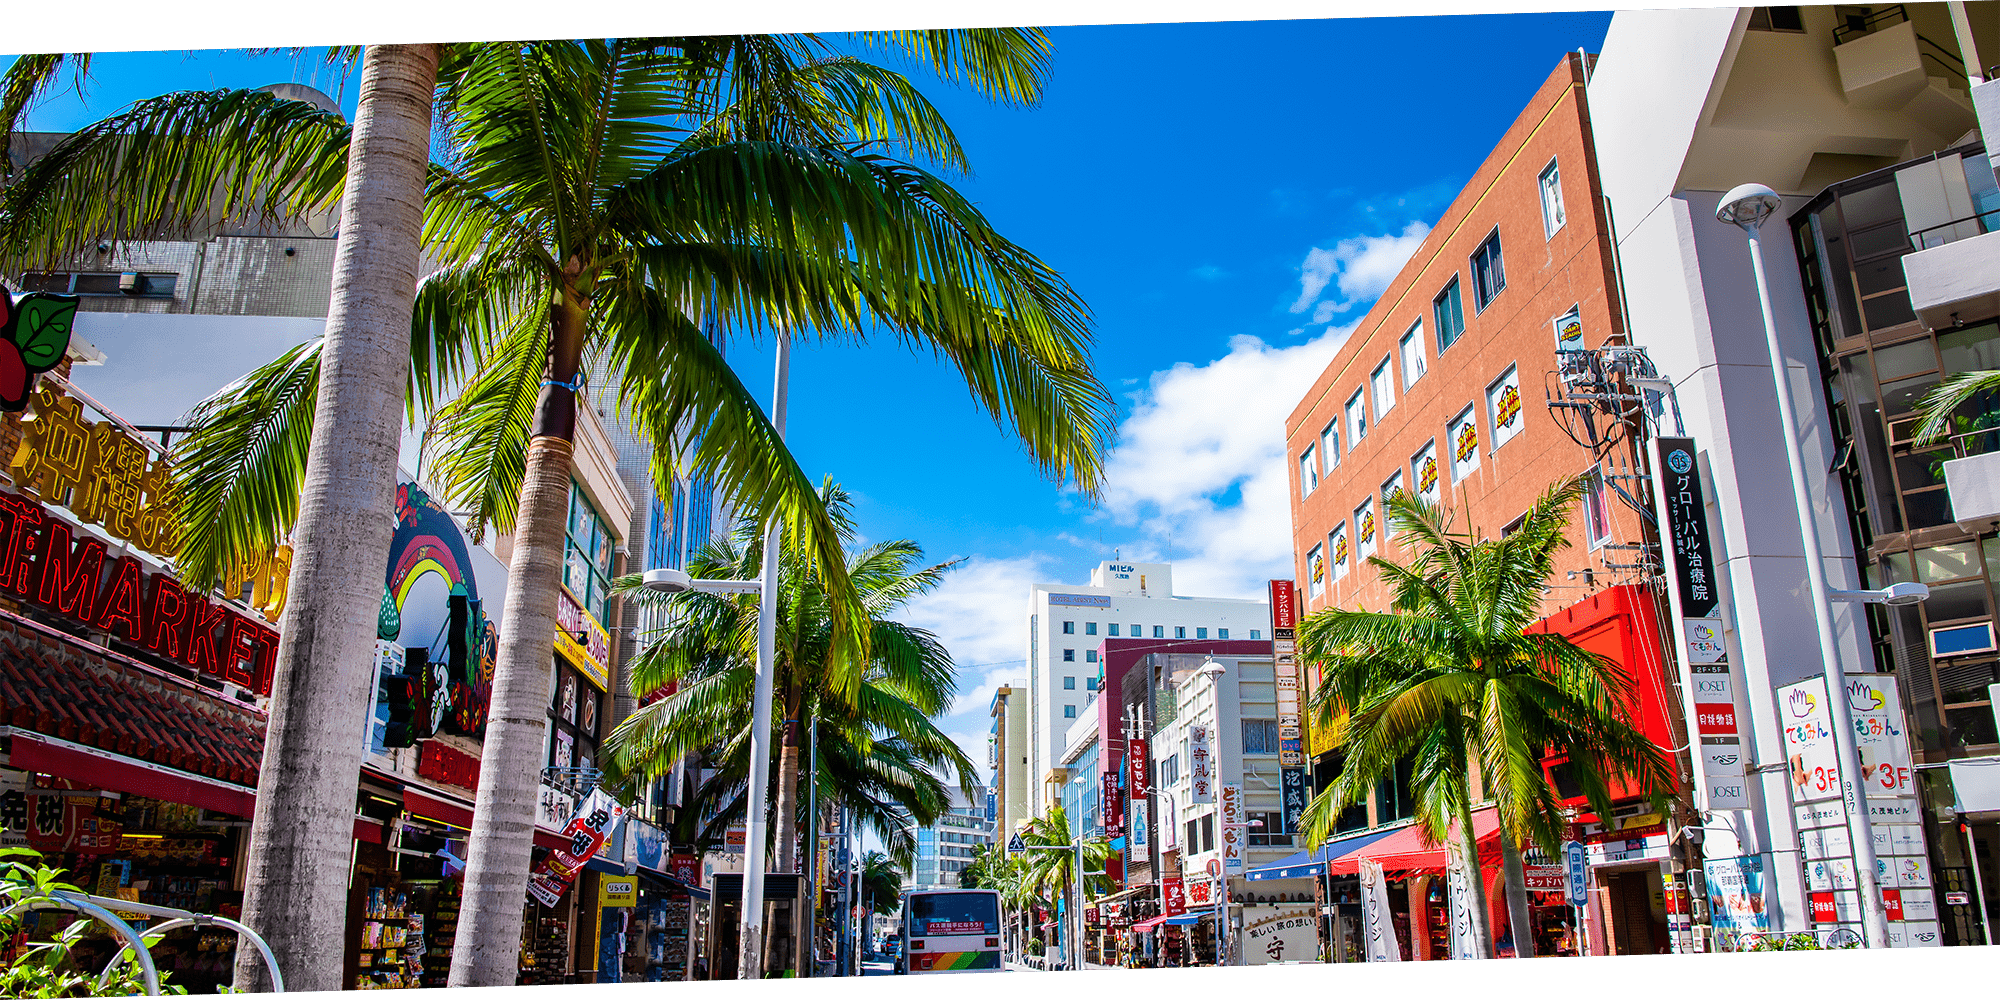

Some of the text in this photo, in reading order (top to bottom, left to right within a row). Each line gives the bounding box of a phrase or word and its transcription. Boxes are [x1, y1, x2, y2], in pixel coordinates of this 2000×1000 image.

[1677, 476, 1708, 600] グローバル治療院
[1109, 564, 1135, 573] MIビル
[0, 496, 281, 697] MARKET
[1711, 609, 1720, 618] 3F
[1690, 642, 1721, 652] てもみん
[1698, 680, 1726, 693] JOSET
[1786, 721, 1829, 744] てもみん
[1855, 718, 1900, 736] もみん
[1814, 766, 1838, 792] 3F
[1879, 763, 1910, 790] 3F
[1712, 786, 1741, 798] JOSET
[0, 788, 66, 837] 免税
[1802, 810, 1839, 820] GS久茂地ビル
[1871, 807, 1910, 815] 久茂地ビル
[571, 808, 610, 858] 免税
[1527, 877, 1564, 887] キッドハ
[1572, 853, 1584, 895] 国際通り
[608, 883, 631, 893] りらくる
[1266, 935, 1285, 961] 守
